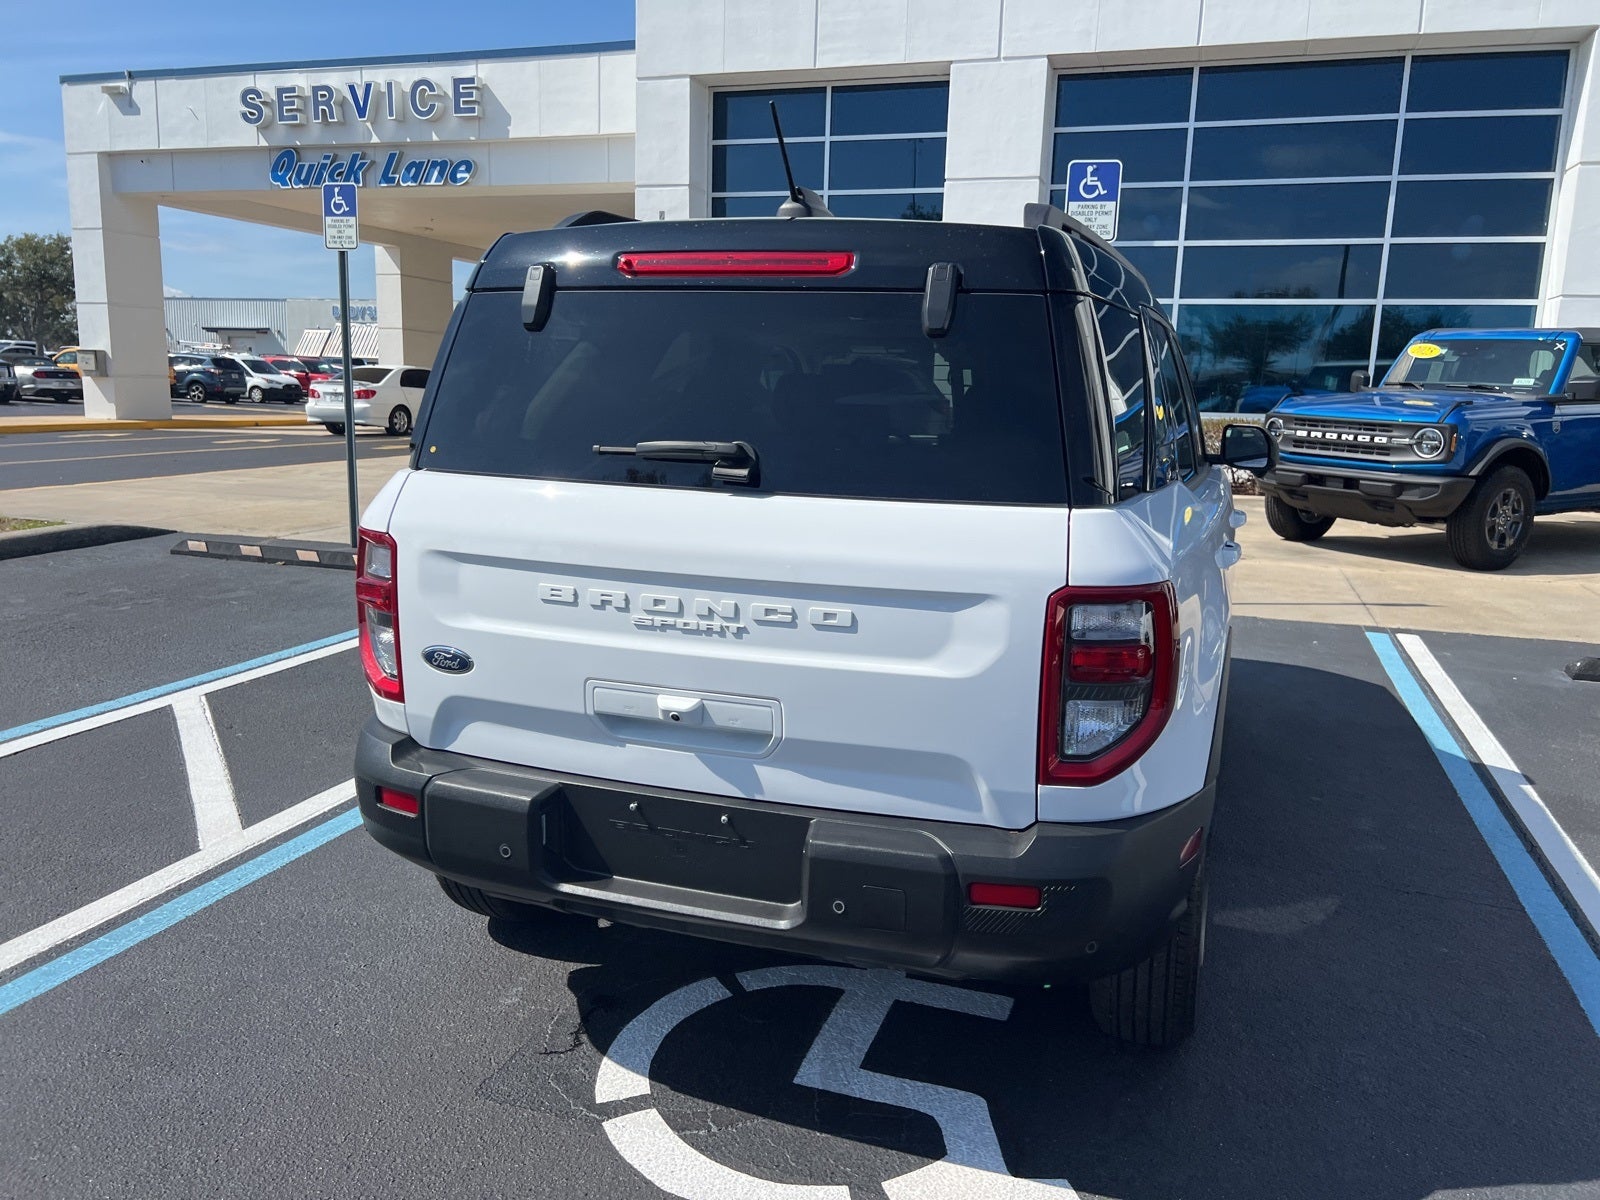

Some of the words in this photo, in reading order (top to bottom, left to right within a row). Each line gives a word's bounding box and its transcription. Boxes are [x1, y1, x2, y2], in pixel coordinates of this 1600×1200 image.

[240, 76, 482, 127] SERVICE
[270, 148, 374, 189] Quick
[379, 150, 477, 187] Lane
[332, 305, 366, 321] BDY
[1295, 429, 1388, 444] BRONCO
[538, 582, 855, 628] BRONCO
[631, 614, 747, 634] SPORT
[431, 651, 460, 669] Ford
